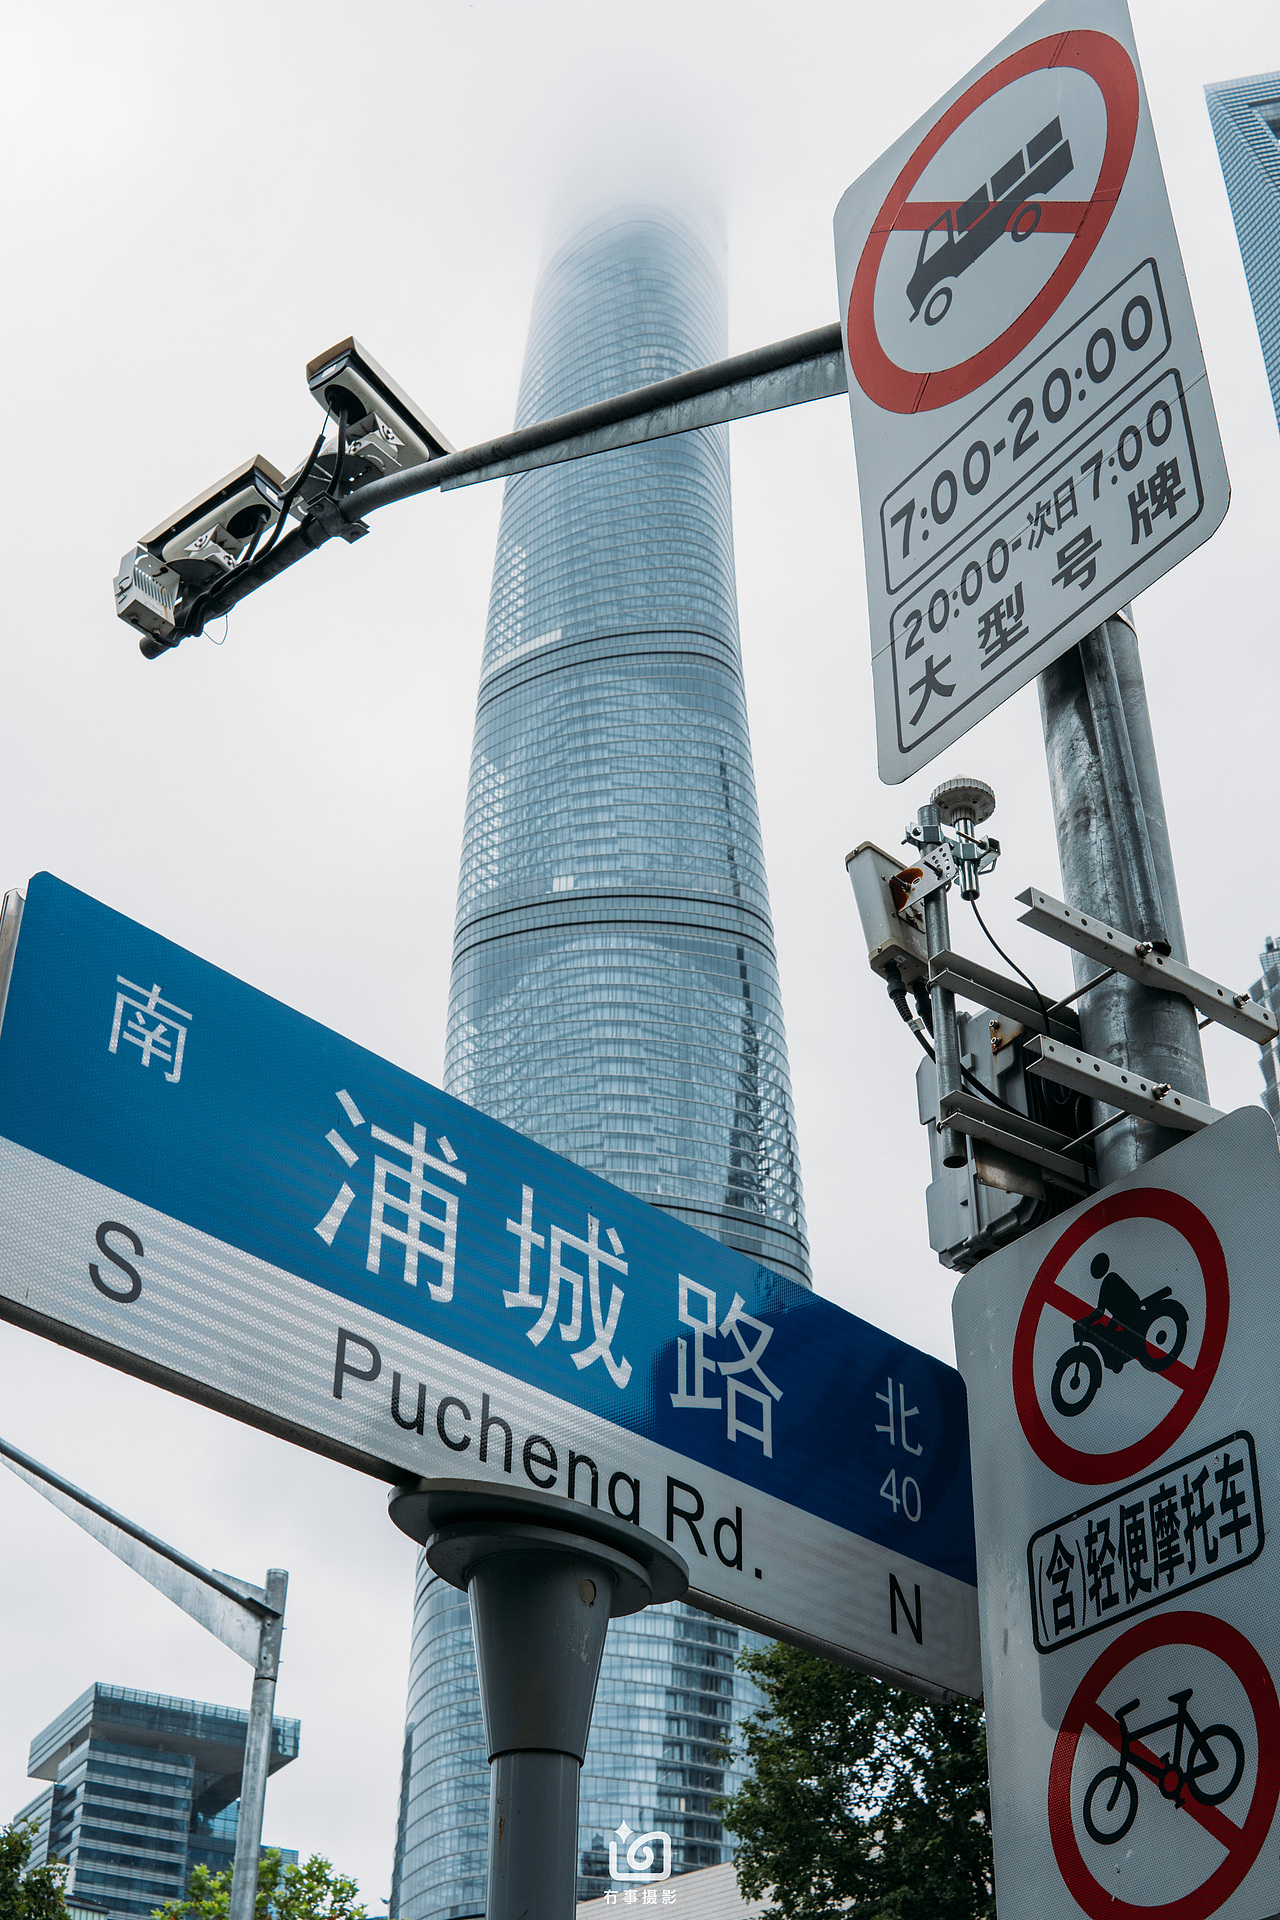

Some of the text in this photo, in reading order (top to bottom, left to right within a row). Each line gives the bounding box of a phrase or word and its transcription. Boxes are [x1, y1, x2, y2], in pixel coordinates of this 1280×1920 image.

[889, 294, 1154, 560] 7:00-20:00
[907, 456, 1187, 727] 大型号牌
[107, 974, 193, 1084] 南
[88, 1220, 145, 1304] S
[312, 1088, 785, 1461] 浦城路
[874, 1376, 924, 1457] 北
[665, 1475, 763, 1581] Rd.
[879, 1467, 923, 1524] 40
[888, 1572, 924, 1646] N
